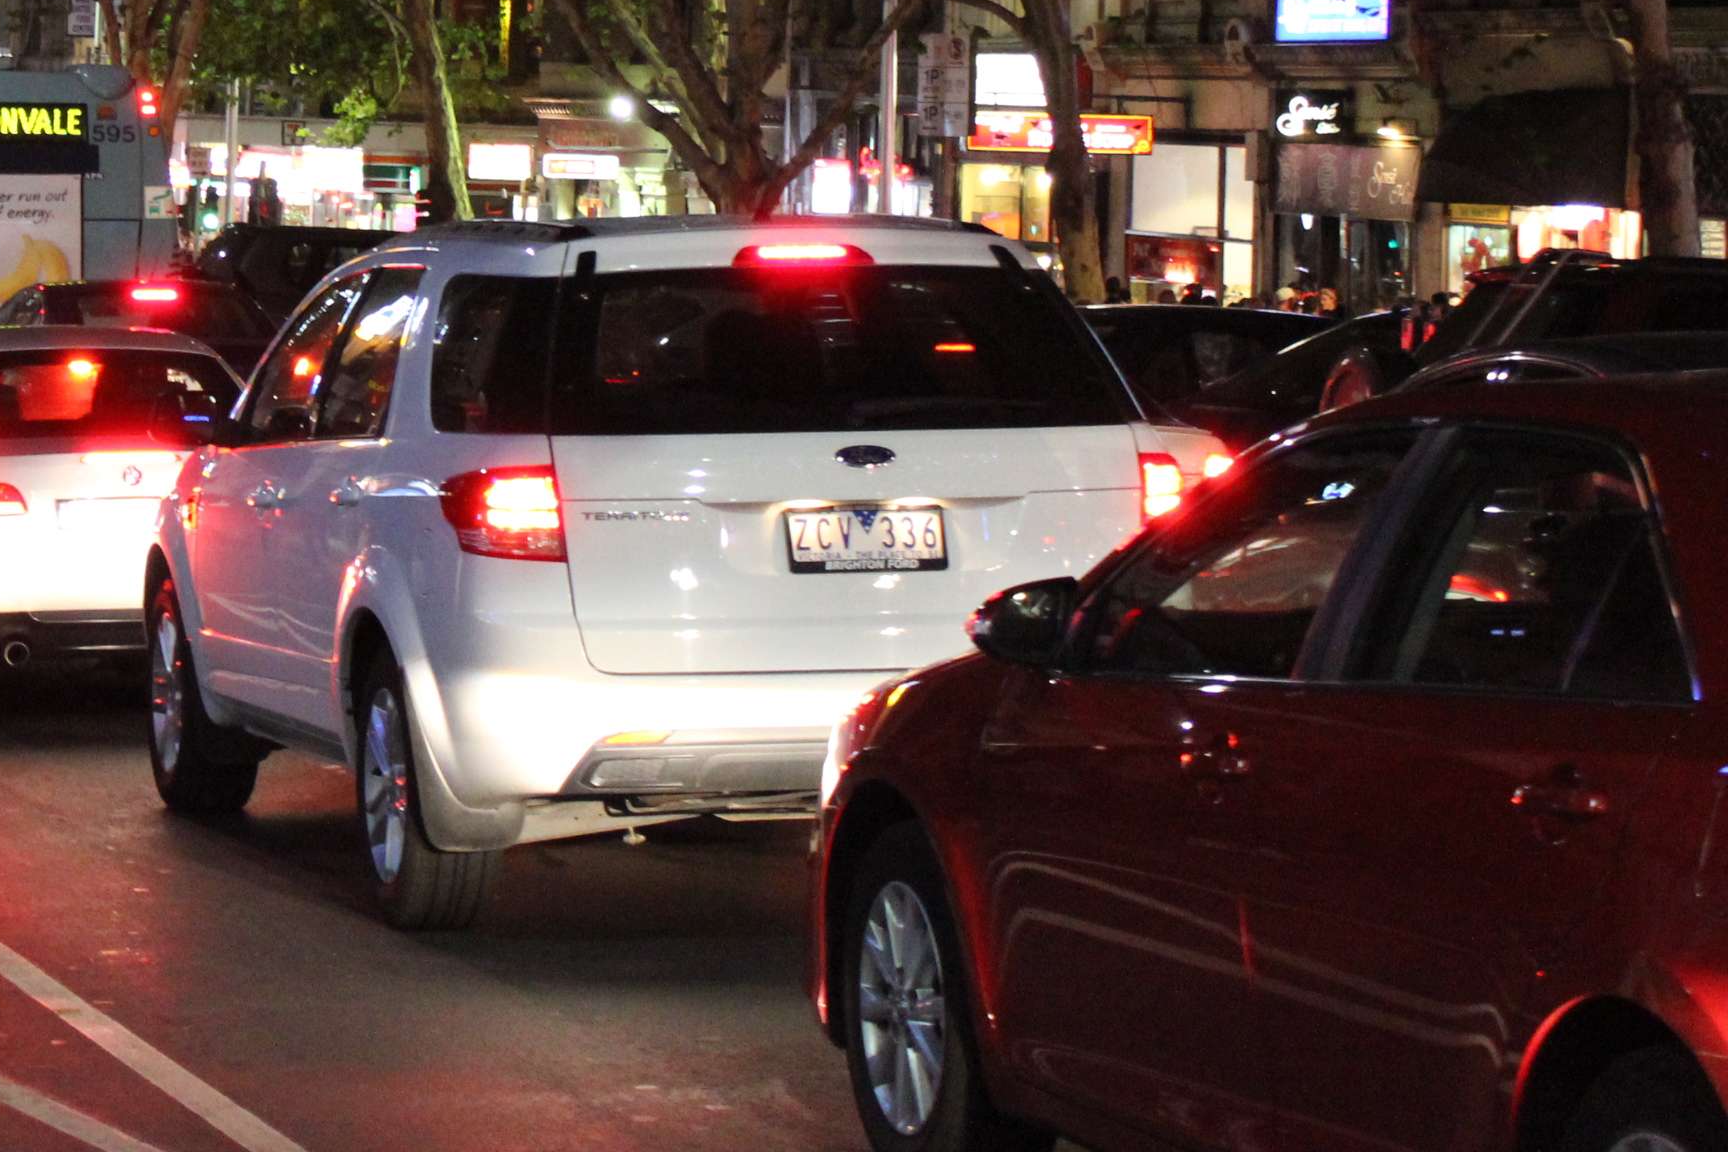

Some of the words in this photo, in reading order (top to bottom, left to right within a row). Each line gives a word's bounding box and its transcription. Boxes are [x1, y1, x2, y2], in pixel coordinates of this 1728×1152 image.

[91, 124, 136, 143] 595
[17, 191, 42, 203] run
[45, 188, 68, 203] out
[7, 208, 56, 225] energy.
[795, 516, 852, 551] ZCV
[880, 515, 937, 549] 336
[825, 559, 884, 571] BRIGHTON
[887, 559, 920, 570] FORD
